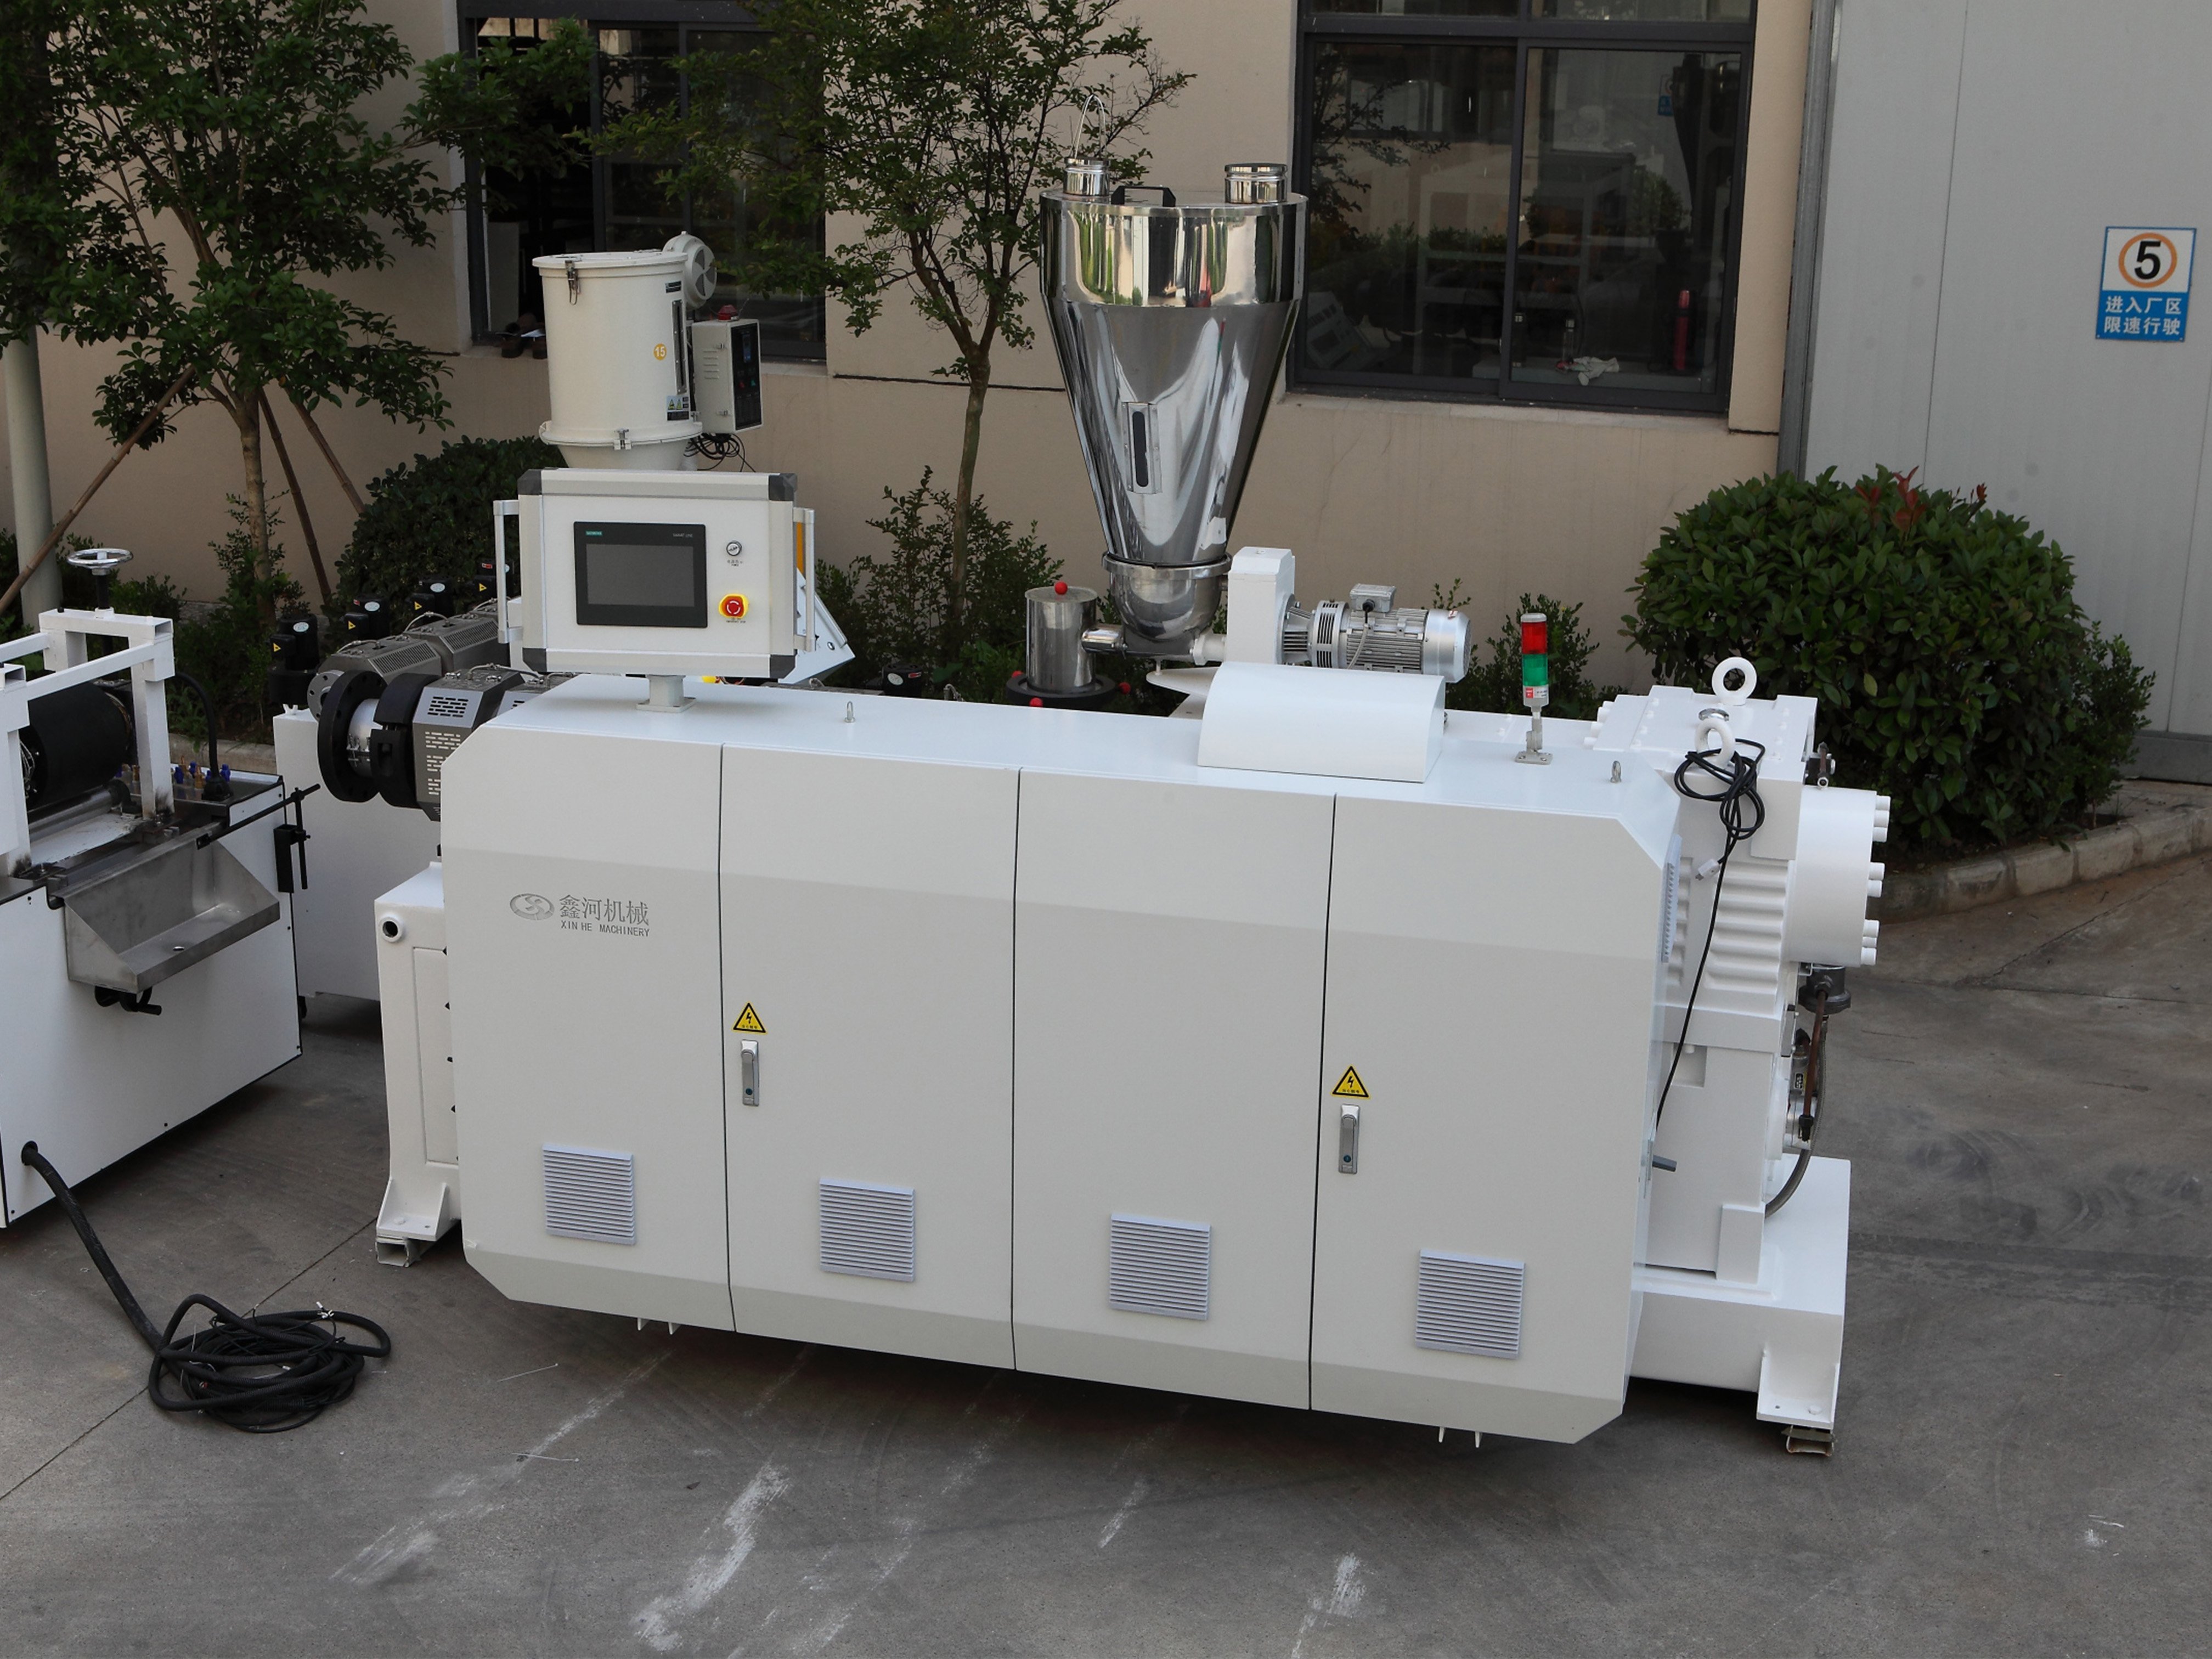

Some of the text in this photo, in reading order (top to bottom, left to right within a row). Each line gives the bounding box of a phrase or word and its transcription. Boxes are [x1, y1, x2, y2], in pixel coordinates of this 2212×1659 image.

[2134, 240, 2162, 280] 5
[2105, 295, 2182, 315] 进入厂区
[2103, 315, 2181, 336] 限速行驶
[654, 346, 666, 357] 15
[558, 894, 650, 926] 鑫河机械
[599, 924, 650, 937] MACHINERY
